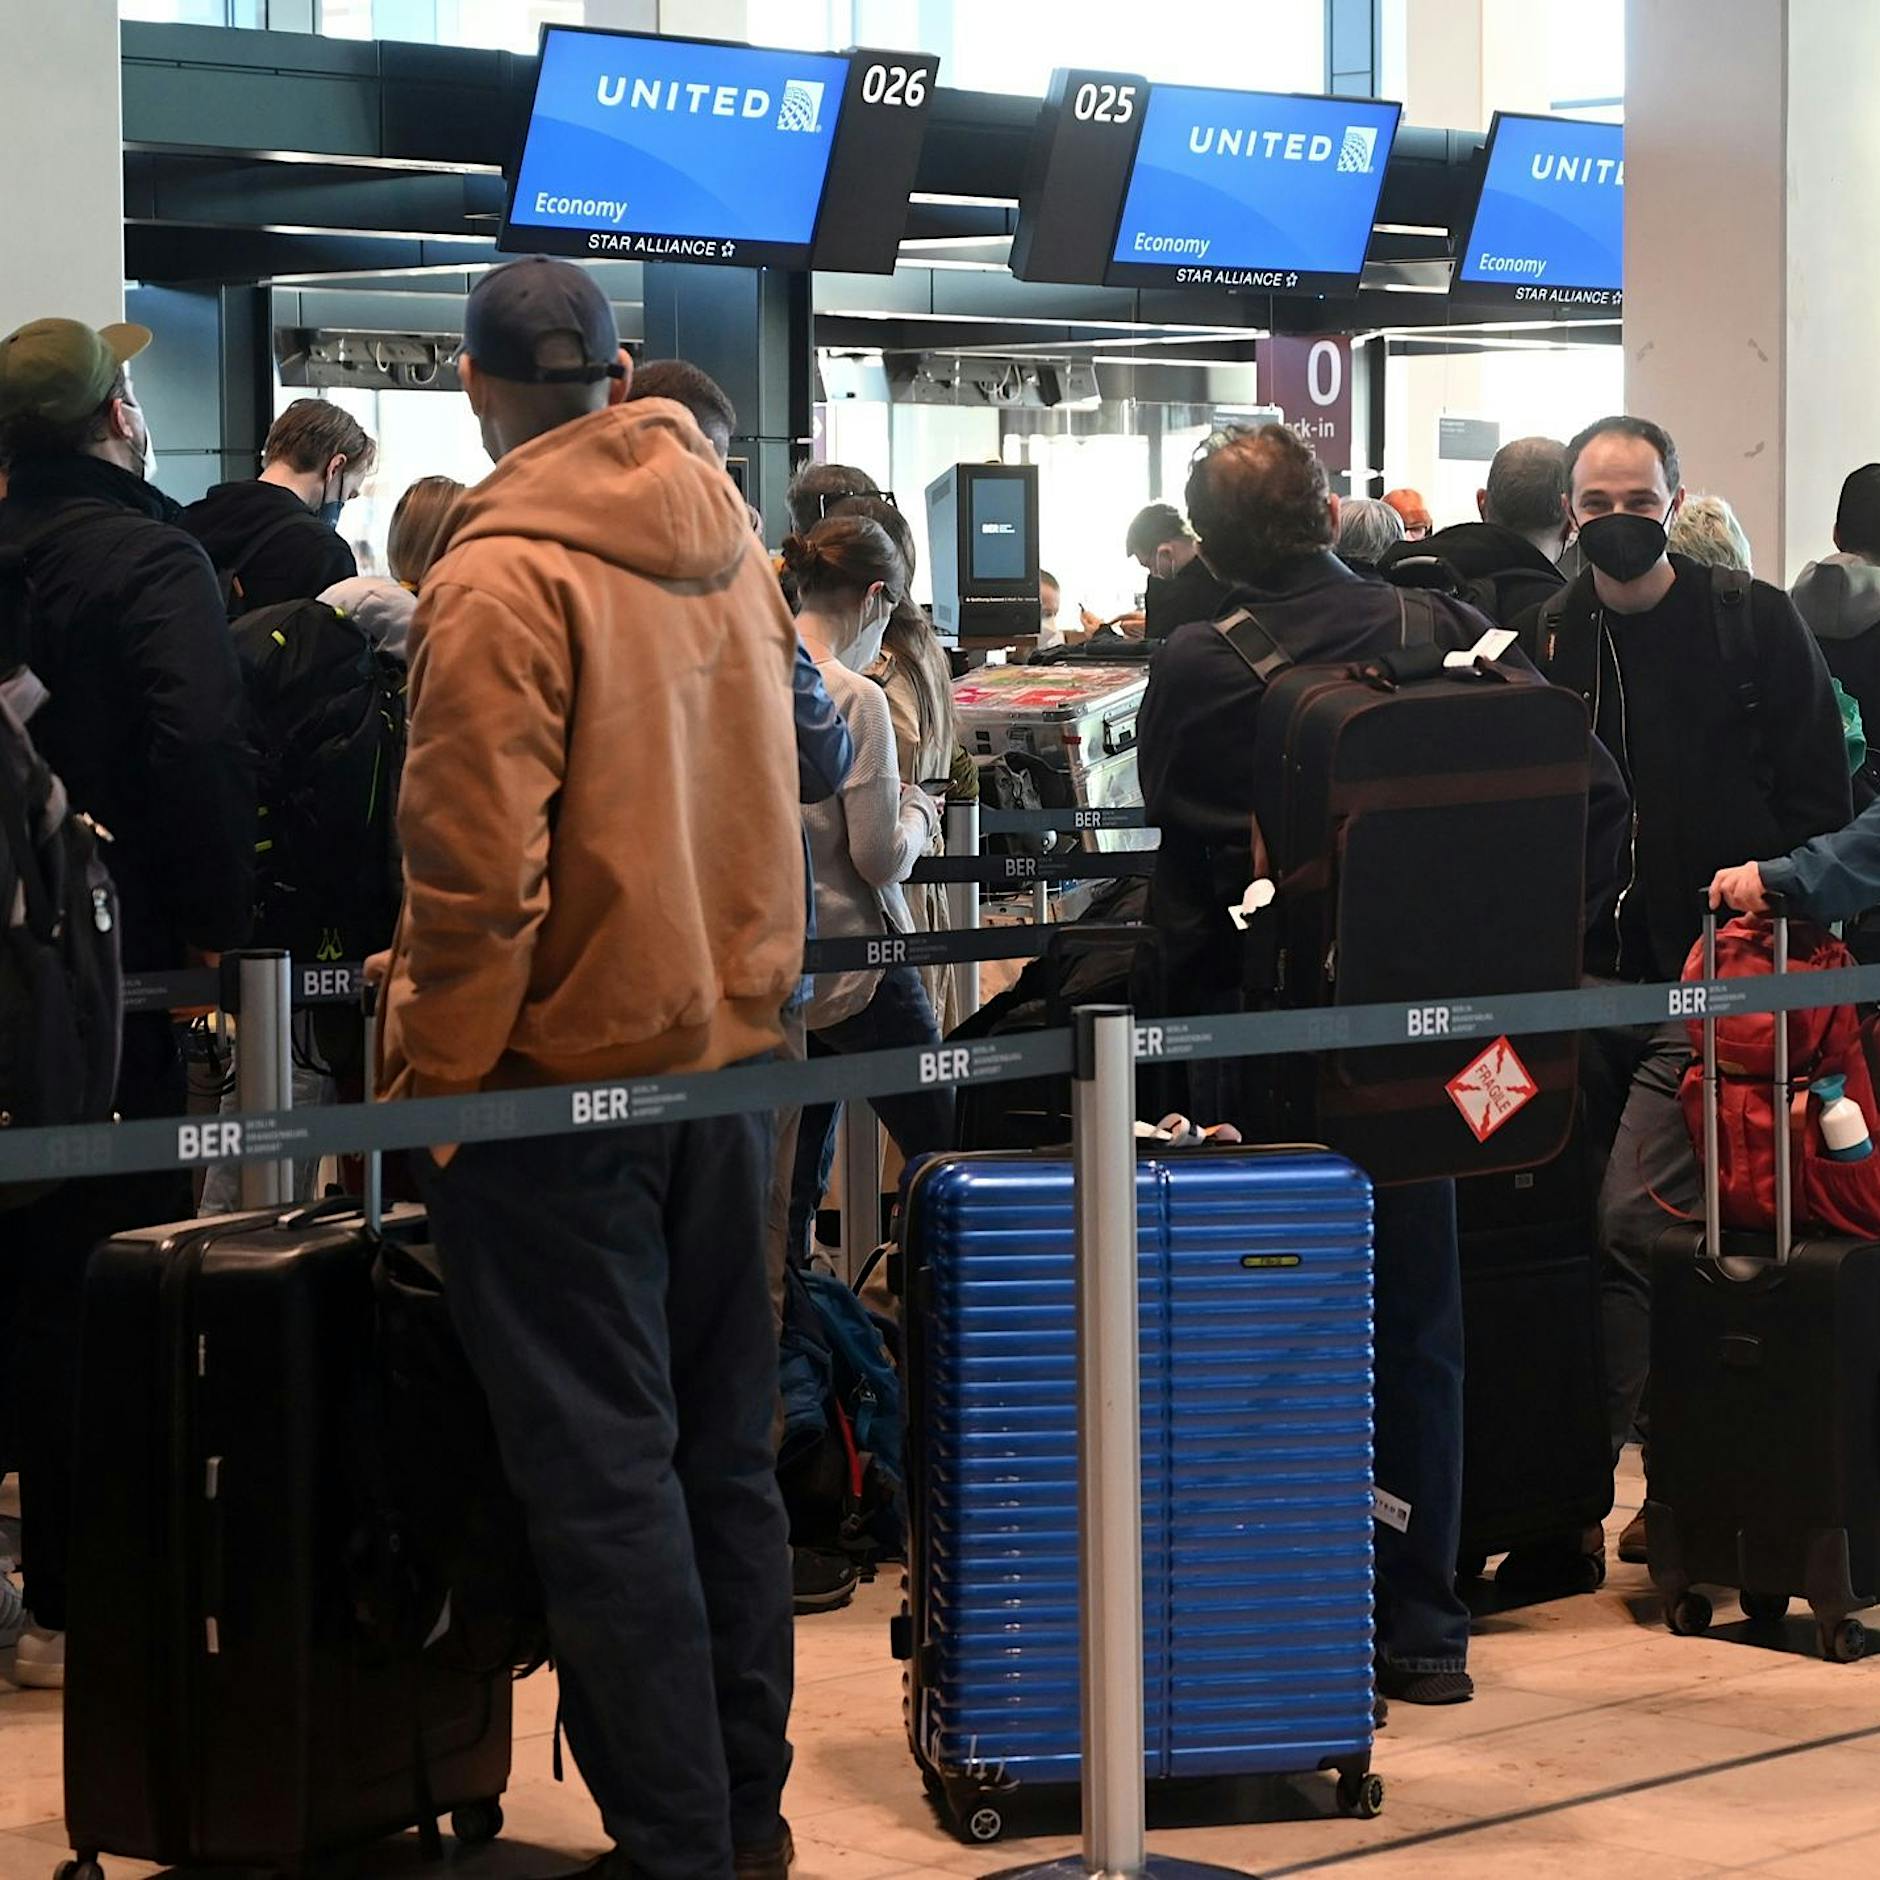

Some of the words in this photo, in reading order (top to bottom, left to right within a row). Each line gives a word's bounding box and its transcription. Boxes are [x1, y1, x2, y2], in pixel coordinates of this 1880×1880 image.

[597, 75, 770, 118] UNITED
[862, 64, 927, 107] 026
[1074, 83, 1136, 124] 025
[1189, 126, 1332, 162] UNITED
[1531, 153, 1624, 186] UNIT
[534, 192, 628, 223] Economy
[588, 233, 632, 251] STAR
[634, 237, 717, 257] ALLIANCE
[1134, 232, 1211, 259] Economy
[1176, 267, 1212, 285] STAR
[1213, 269, 1283, 287] ALLIANCE
[1479, 253, 1547, 277] Economy
[1514, 287, 1547, 302] STAR
[1548, 289, 1610, 305] ALLIANCE
[1307, 340, 1342, 406] 0
[1075, 811, 1101, 828] BER
[1005, 857, 1036, 877] BER
[867, 940, 906, 964] BER
[303, 969, 350, 995] BER
[1668, 987, 1707, 1016] BER
[1407, 1006, 1449, 1036] BER
[1135, 1026, 1163, 1057] ER
[920, 1048, 970, 1083] BER
[1475, 1064, 1511, 1113] FRAGILE
[572, 1087, 629, 1124] BER
[178, 1121, 242, 1160] BER
